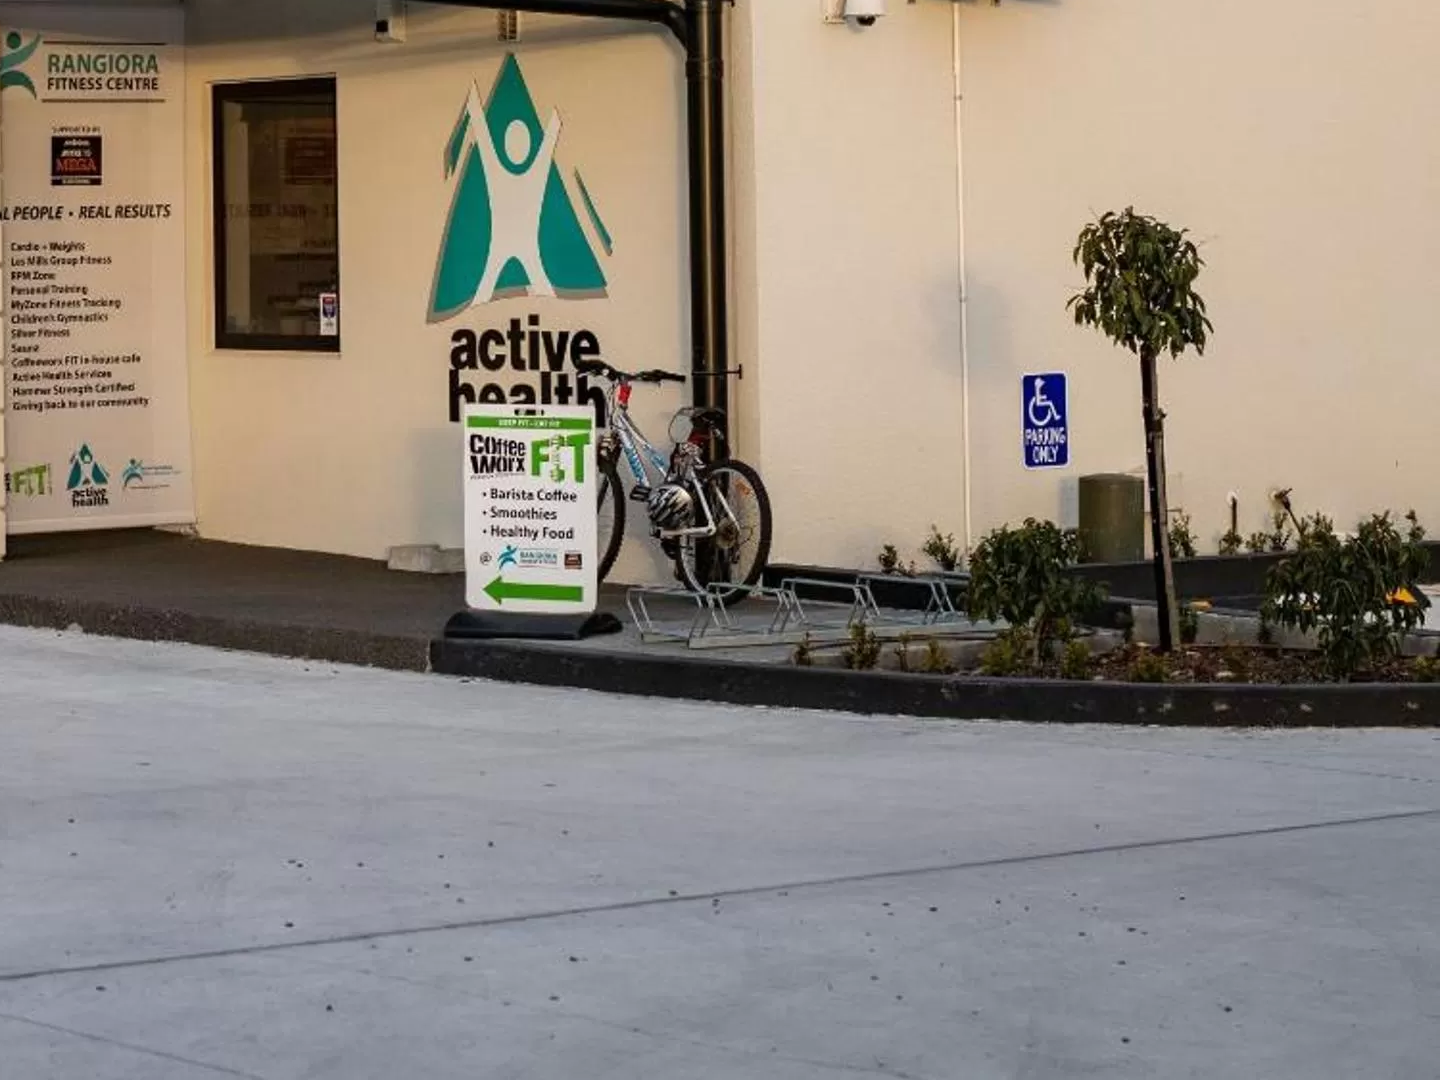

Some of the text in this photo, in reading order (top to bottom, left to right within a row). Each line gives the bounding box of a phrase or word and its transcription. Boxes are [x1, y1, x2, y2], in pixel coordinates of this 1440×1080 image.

[47, 54, 159, 74] RANGIORA
[47, 76, 159, 91] FITNESS CENTRE
[13, 205, 64, 221] PEOPLE
[78, 205, 112, 220] REAL
[115, 204, 172, 219] RESULTS
[80, 255, 113, 265] Fitness
[449, 314, 601, 372] active
[64, 355, 79, 365] FIT
[74, 369, 113, 379] Services
[1025, 427, 1066, 446] PARKING
[531, 432, 591, 483] FIT
[1032, 445, 1059, 463] ONLY
[72, 496, 109, 508] health
[490, 488, 578, 502] Barista Coffee
[490, 506, 558, 521] Smoothies
[490, 524, 575, 541] Healthy Food
